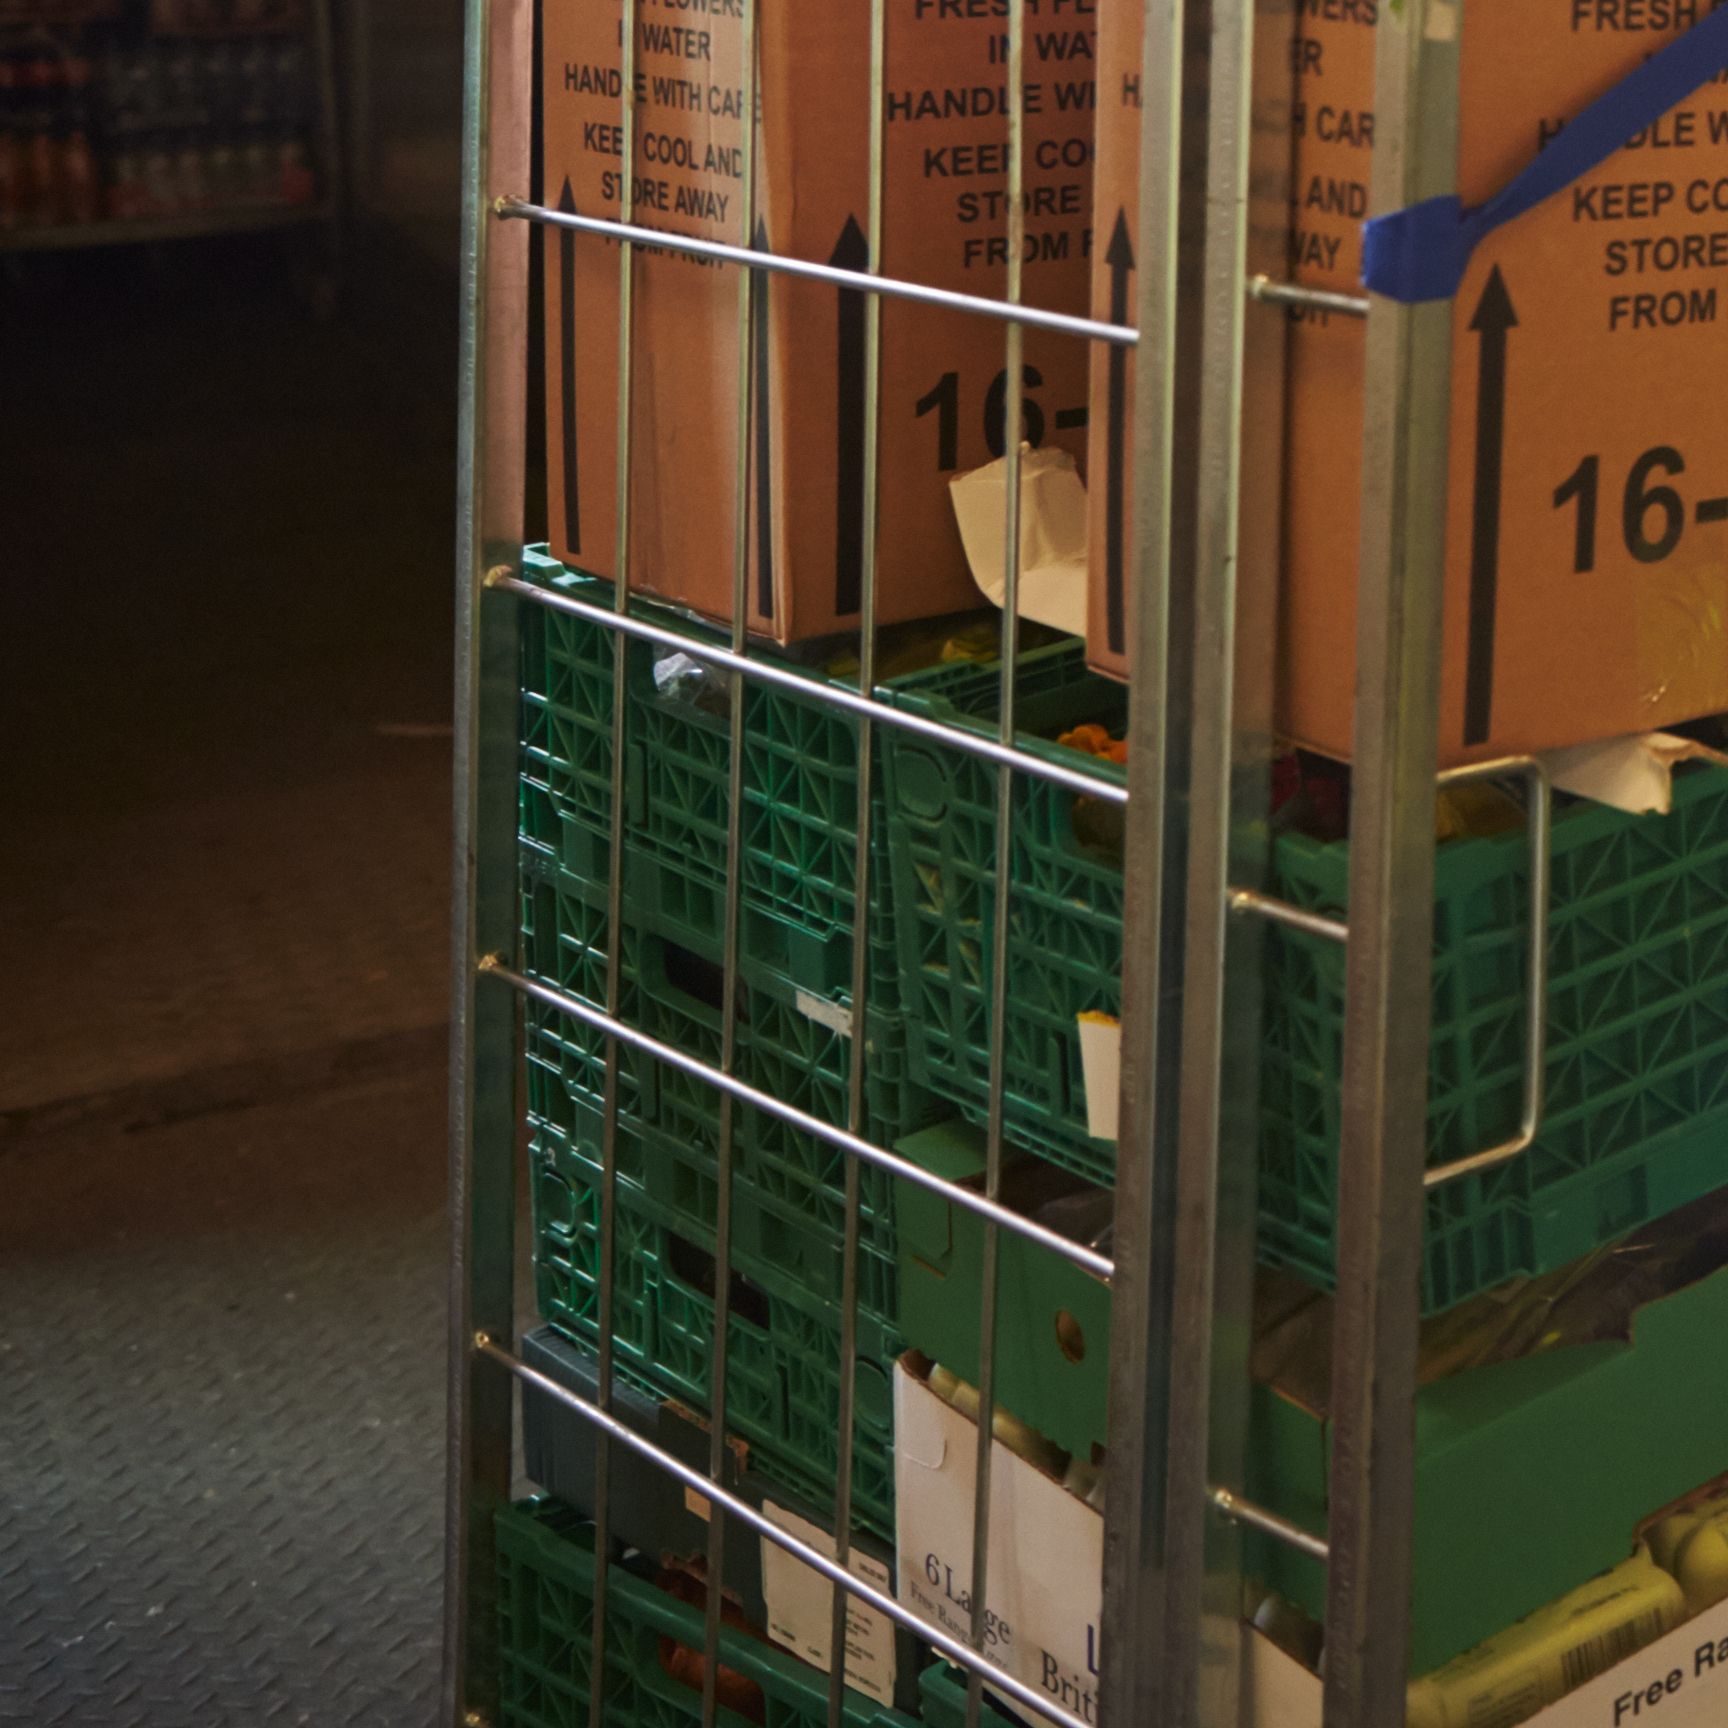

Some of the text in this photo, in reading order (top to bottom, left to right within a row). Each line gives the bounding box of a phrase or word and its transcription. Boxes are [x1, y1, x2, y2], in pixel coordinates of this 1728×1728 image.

[642, 23, 712, 62] WATER
[565, 63, 648, 104] HANDE
[653, 76, 701, 112] WITH
[887, 83, 1043, 122] HANDLE
[1053, 80, 1097, 113] WI
[583, 122, 626, 157] KEE
[643, 131, 699, 171] COOL
[1315, 105, 1375, 150] CAR
[1035, 137, 1096, 170] CO
[674, 185, 729, 223] AWAY
[957, 184, 1084, 223] STORE
[1307, 175, 1367, 219] AND
[1572, 181, 1674, 223] KEEP
[963, 231, 1070, 268] FROM
[1608, 289, 1717, 333] FROM
[915, 364, 1091, 471] 16-
[925, 1552, 940, 1586] 6
[944, 1563, 1011, 1646] Lage
[1612, 1664, 1684, 1727] Free
